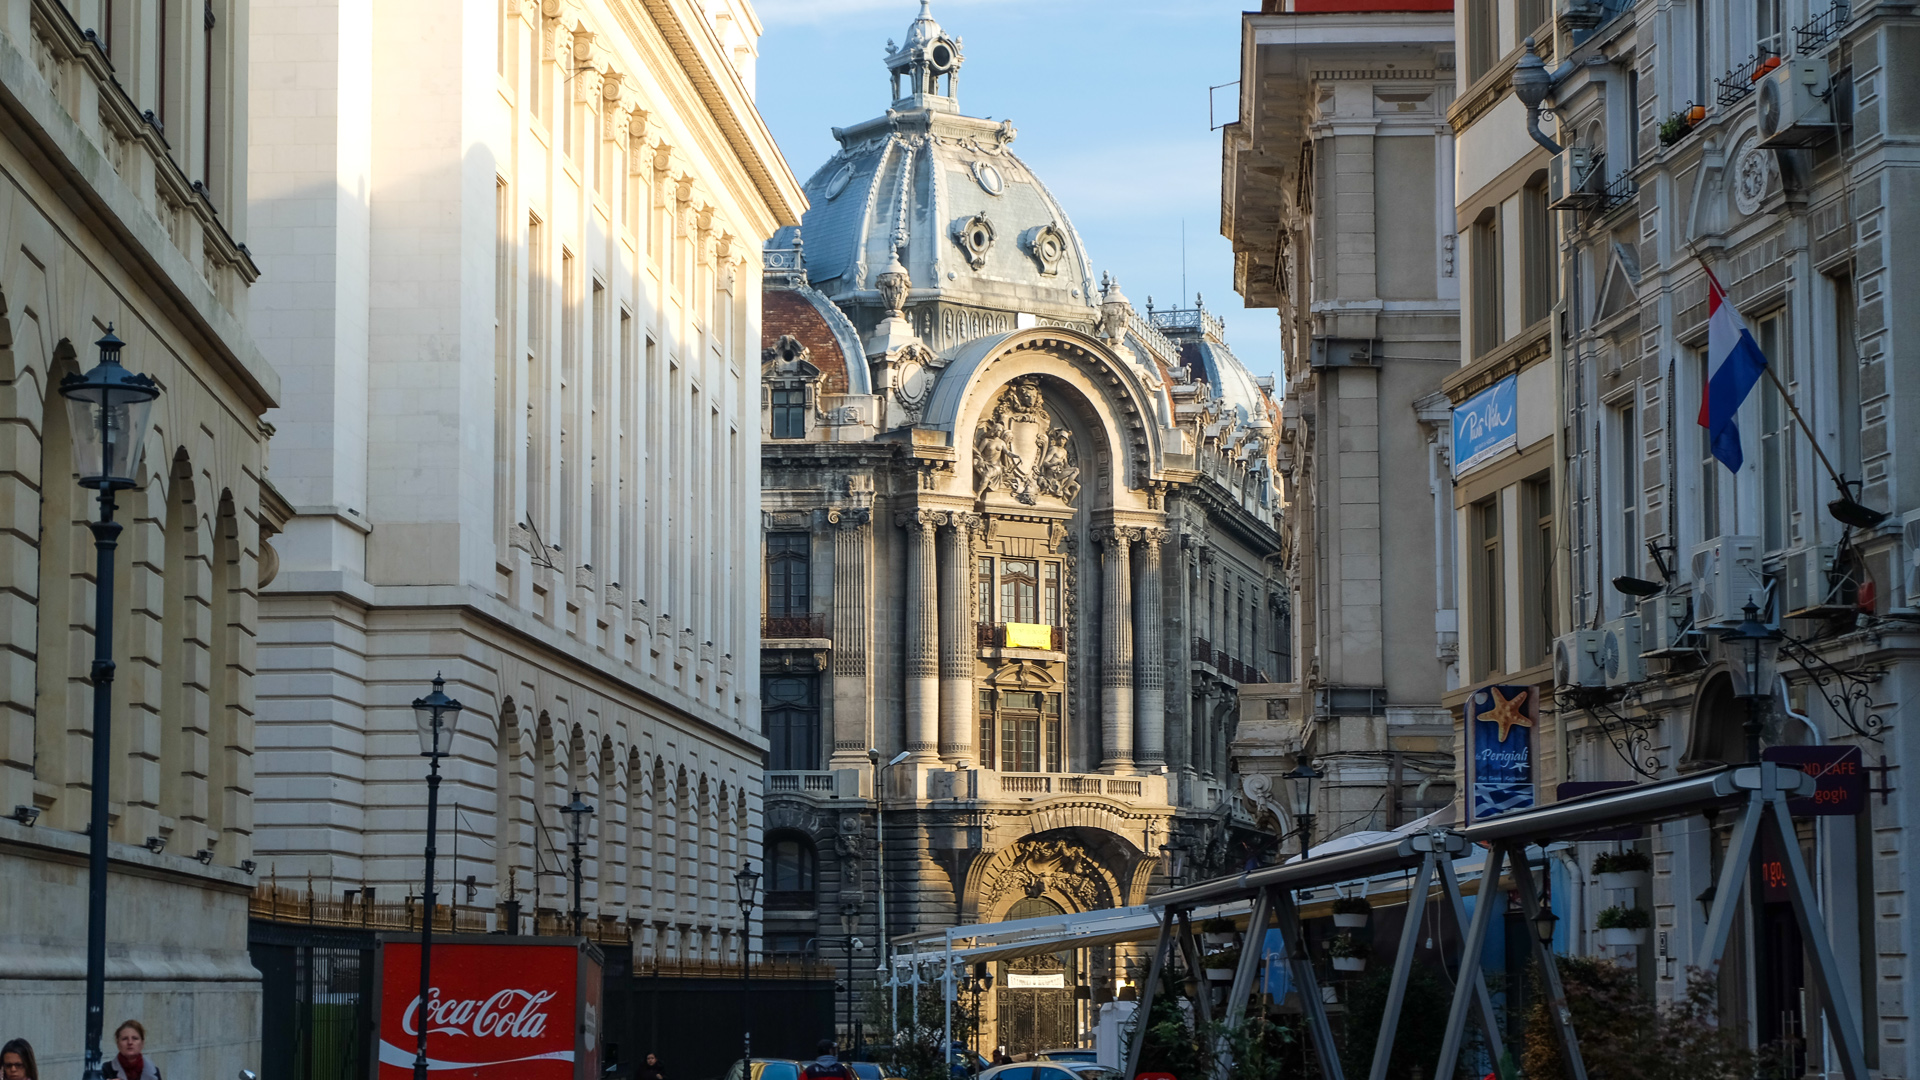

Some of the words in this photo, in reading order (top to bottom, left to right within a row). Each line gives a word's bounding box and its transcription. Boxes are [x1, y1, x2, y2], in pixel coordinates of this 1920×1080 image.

[1485, 384, 1512, 432] Vida
[1481, 746, 1529, 768] Perigiali
[1802, 762, 1821, 775] ND
[1824, 762, 1856, 775] CAFE
[1814, 786, 1847, 804] gogh
[402, 987, 558, 1038] Coca-Cola
